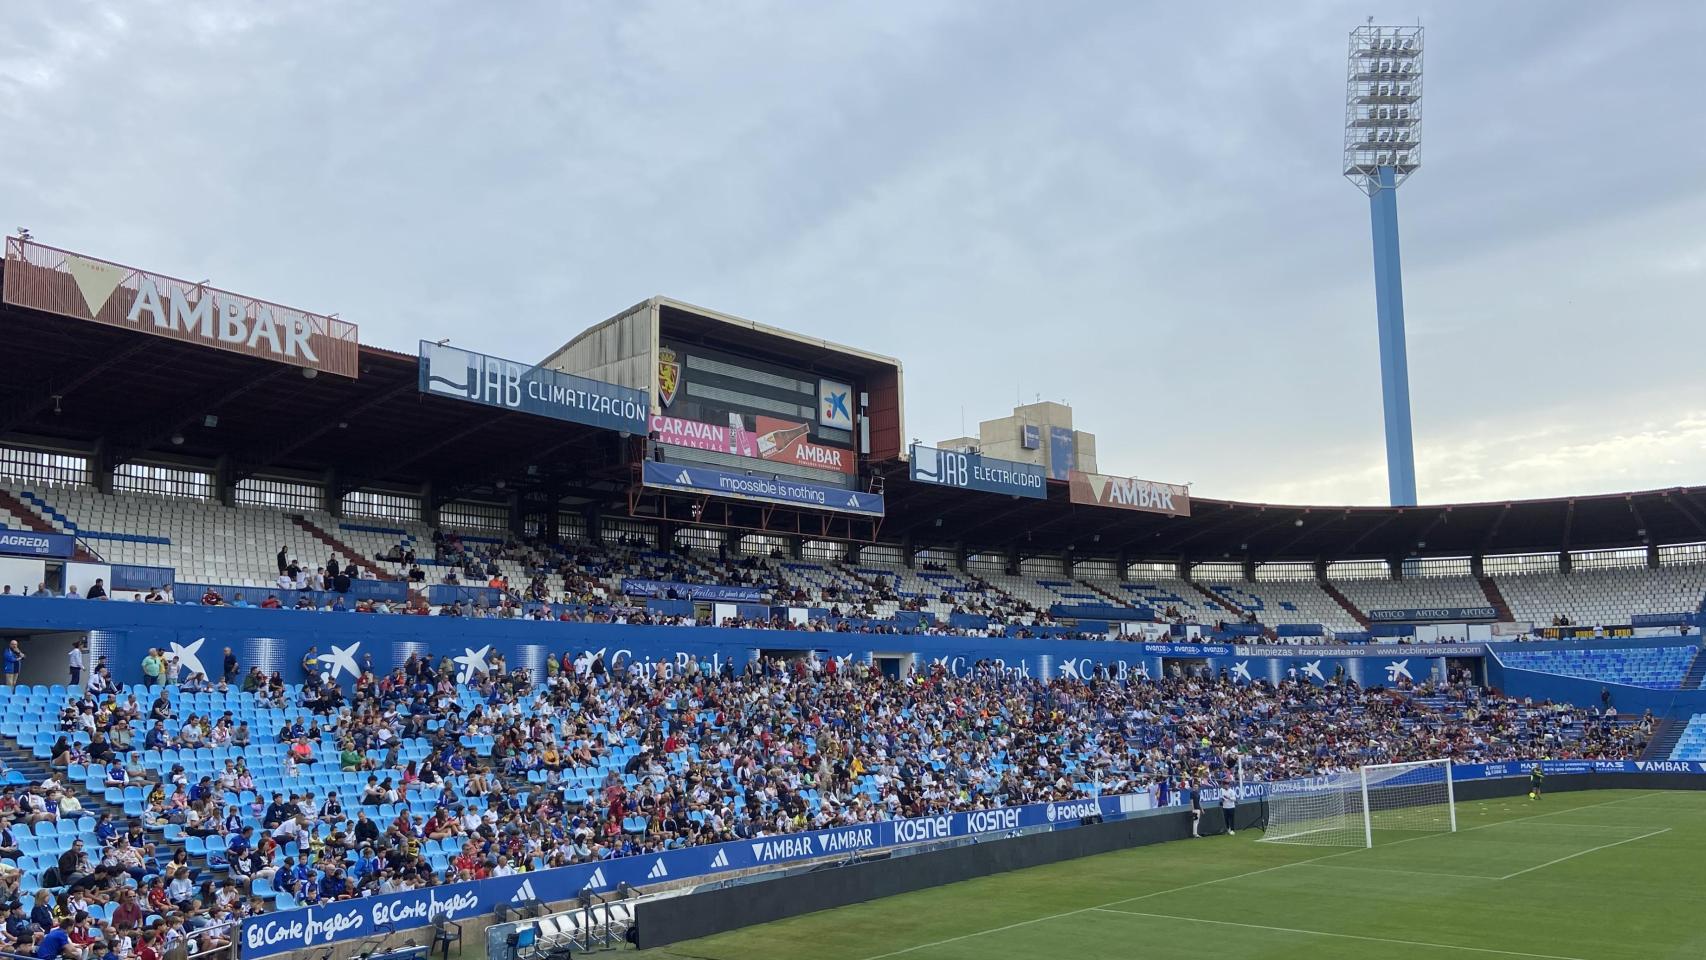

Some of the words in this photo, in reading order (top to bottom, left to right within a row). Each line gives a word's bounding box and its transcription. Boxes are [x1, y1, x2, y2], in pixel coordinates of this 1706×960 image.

[127, 279, 319, 362] AMBAR
[471, 355, 521, 407] JAB
[528, 381, 645, 422] CLIMATIZACIÓN
[652, 416, 723, 442] CARAVAN
[659, 434, 723, 452] RAGANCIAS
[796, 444, 842, 467] AMBAR
[940, 451, 968, 487] JAB
[974, 465, 1041, 488] ELECTRICIDAD
[720, 474, 776, 494] impossible
[778, 483, 787, 496] is
[788, 486, 825, 504] nothing
[1109, 477, 1175, 511] AMBAR
[0, 535, 49, 548] AGREDA
[1372, 610, 1405, 618] ARTICO
[1416, 609, 1449, 617] ARTICO
[1460, 608, 1495, 617] ARTICO
[1251, 646, 1293, 657] Limpiezas
[1298, 646, 1365, 657] #zaragozateamo
[1377, 645, 1481, 656] www.bcblimpiezas.com
[1645, 761, 1691, 772] AMBAR
[762, 837, 813, 861] AMBAR
[827, 828, 873, 851] AMBAR
[372, 902, 389, 925] El
[389, 900, 427, 922] Corte
[427, 889, 479, 923] Inglés
[247, 924, 264, 950] El
[264, 920, 303, 946] Corte
[304, 908, 364, 946] Inglés
